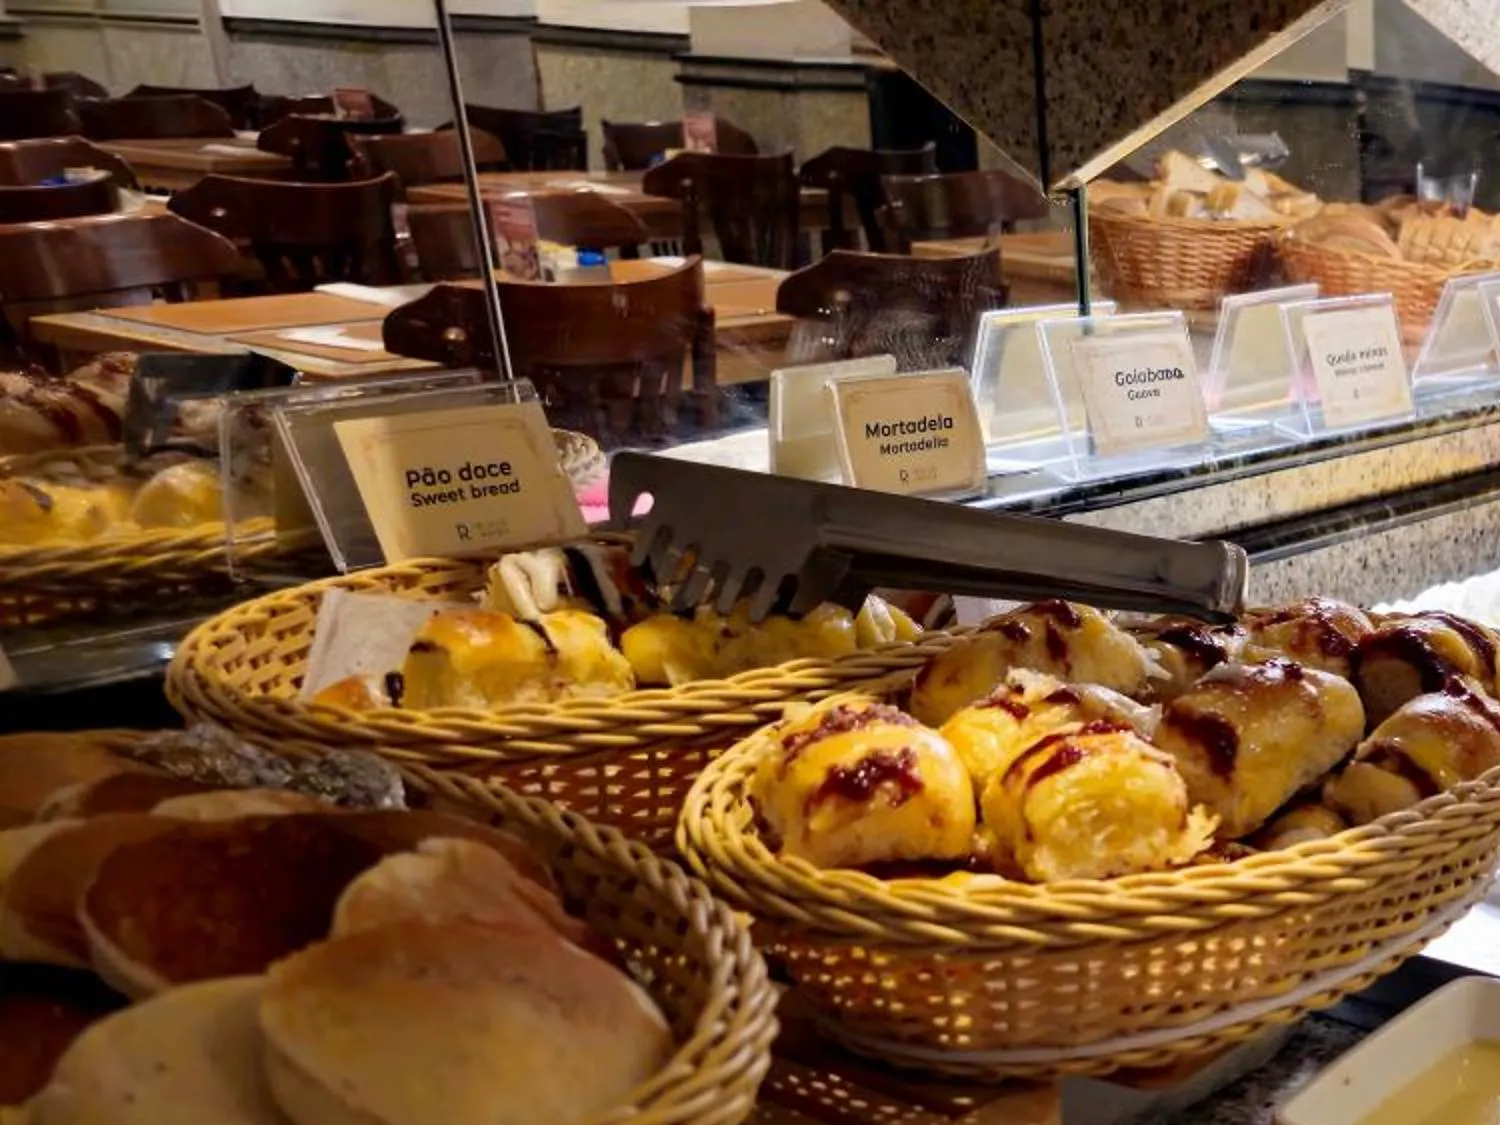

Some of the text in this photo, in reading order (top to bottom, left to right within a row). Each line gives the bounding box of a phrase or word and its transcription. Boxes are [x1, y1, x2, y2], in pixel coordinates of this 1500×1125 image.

[865, 414, 953, 439] Mortadela
[406, 462, 511, 488] Pão doce
[411, 480, 520, 507] Sweet bread
